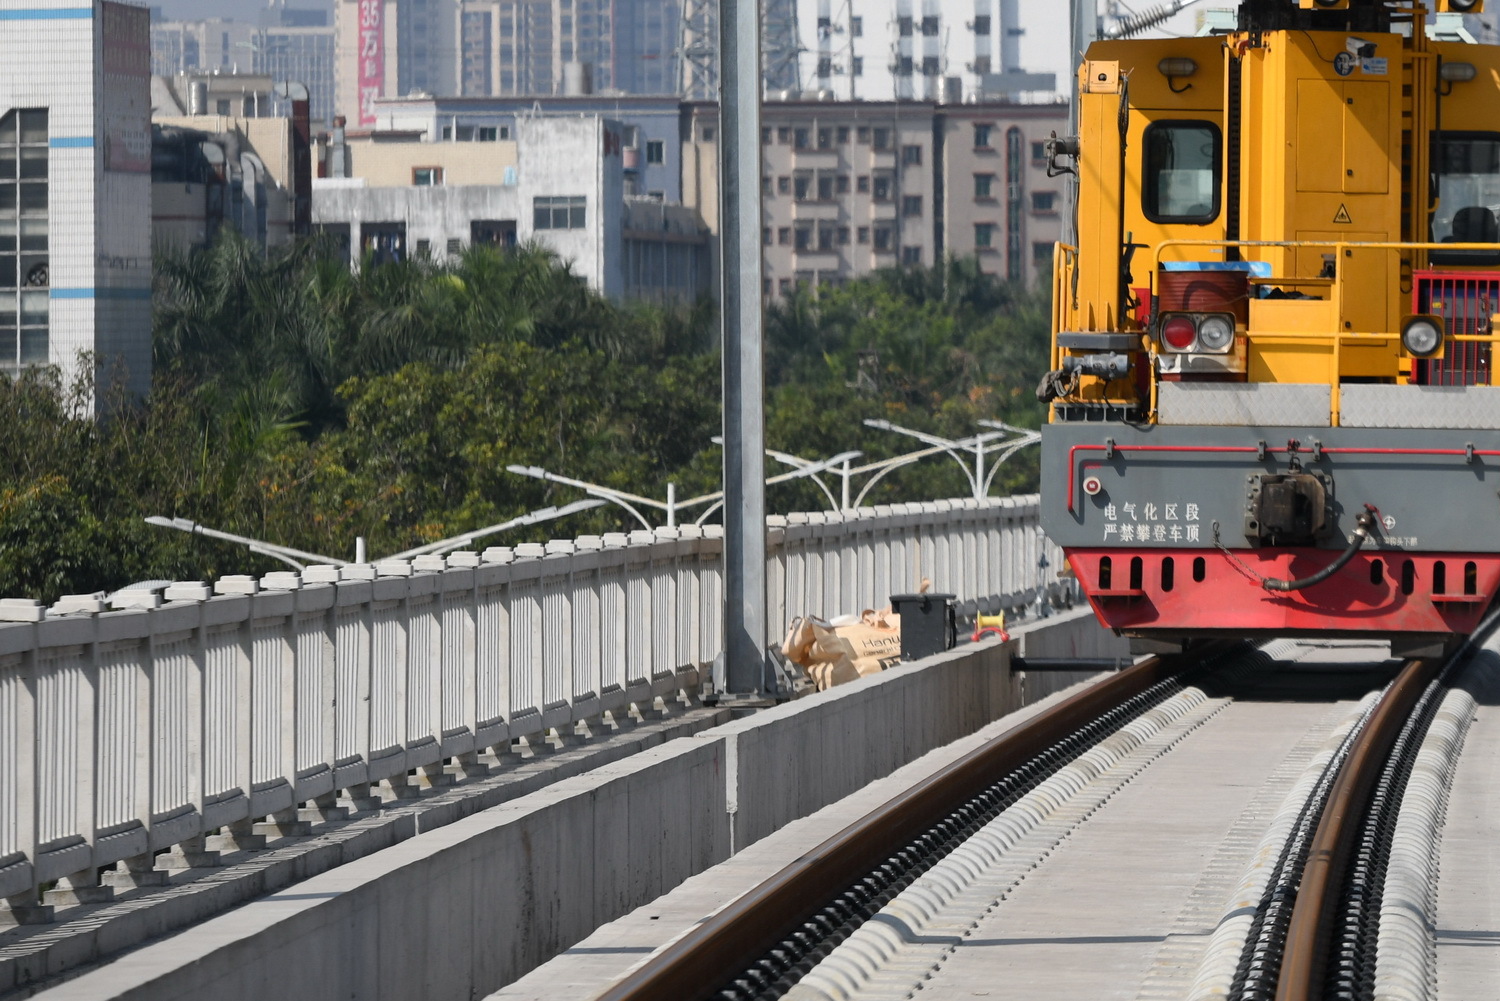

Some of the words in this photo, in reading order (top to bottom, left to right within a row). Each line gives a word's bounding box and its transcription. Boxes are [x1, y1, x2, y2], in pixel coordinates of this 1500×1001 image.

[1104, 502, 1200, 521] 电气化区段
[1103, 523, 1200, 543] 严禁攀登车顶
